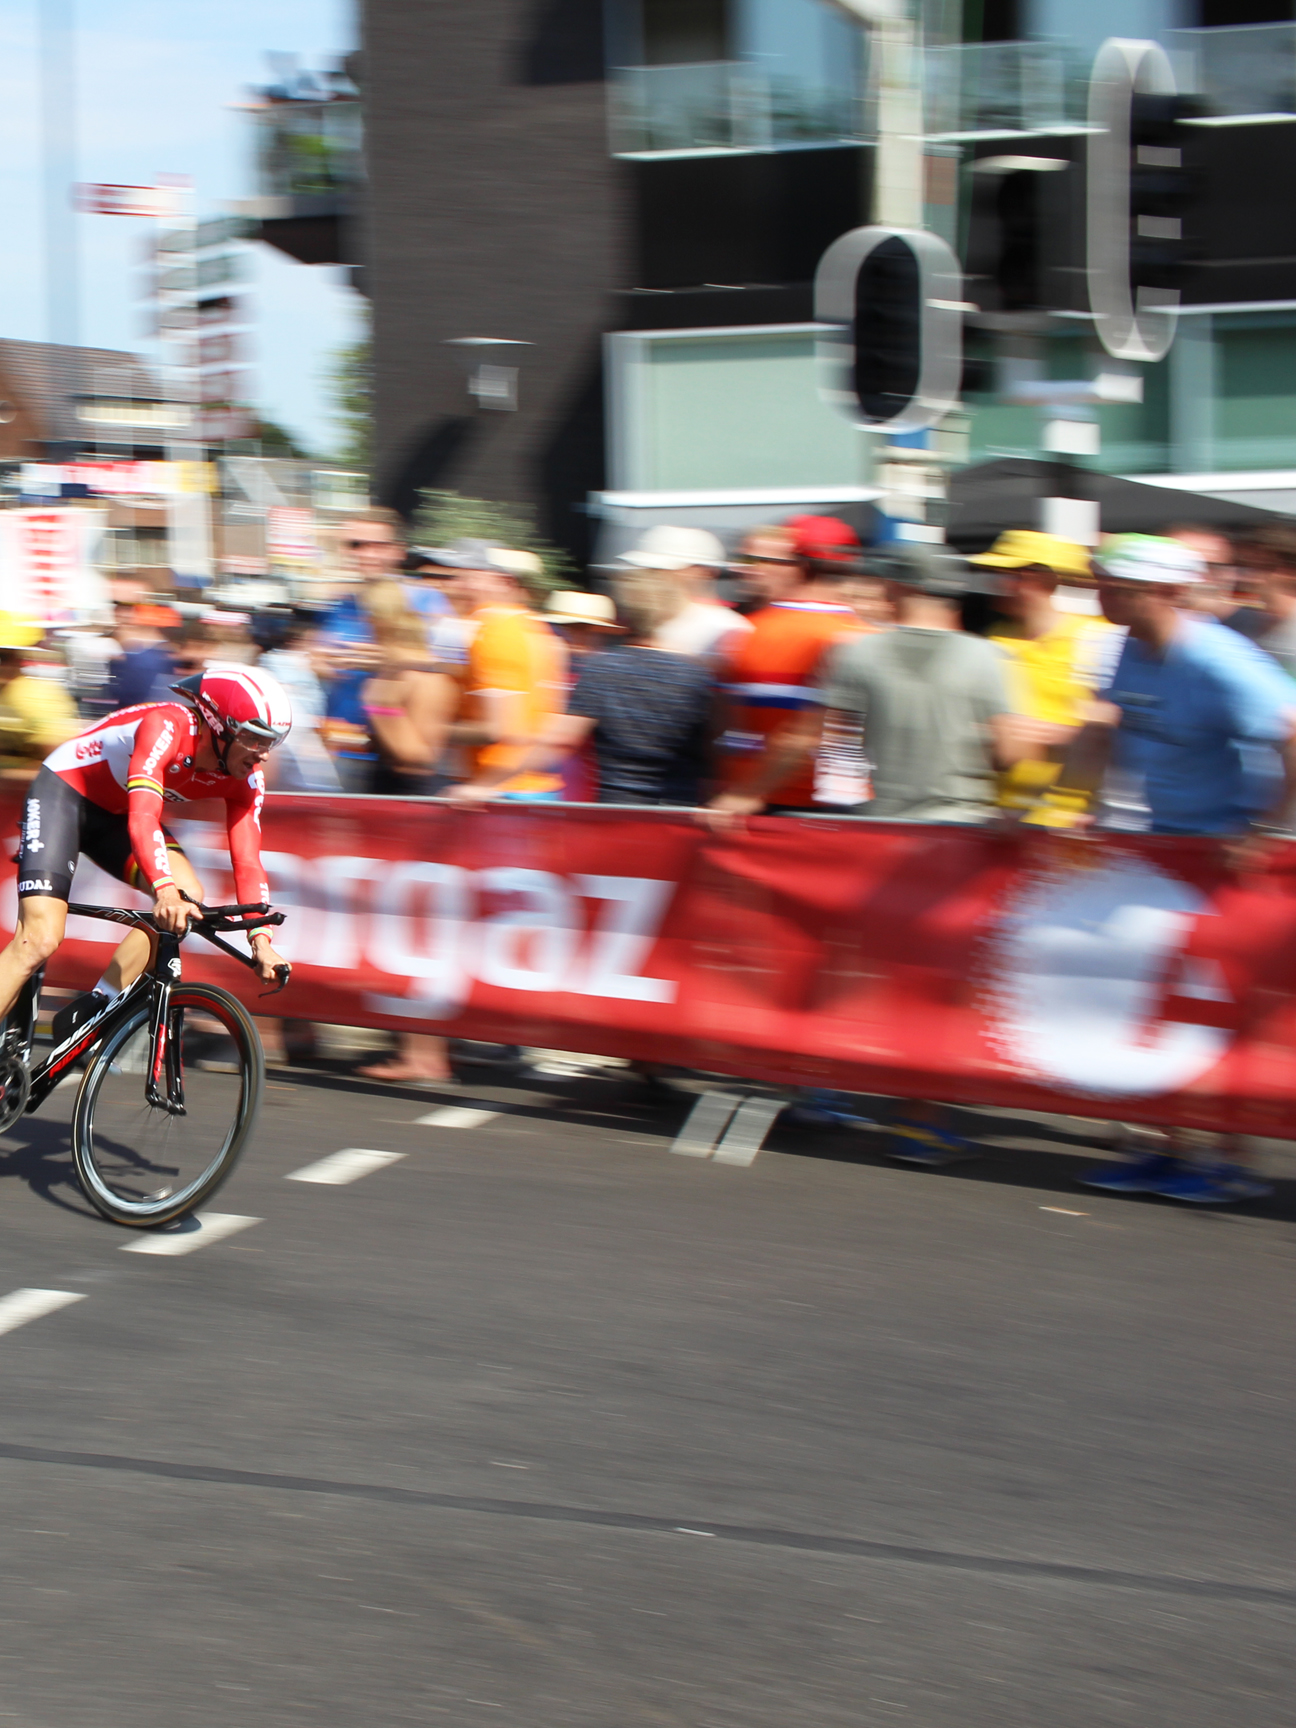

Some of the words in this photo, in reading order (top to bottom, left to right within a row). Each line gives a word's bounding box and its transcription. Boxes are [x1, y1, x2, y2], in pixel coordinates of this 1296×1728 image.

[142, 719, 174, 775] JOKER+
[17, 879, 53, 892] UDAL
[46, 973, 142, 1065] RIDLEY
